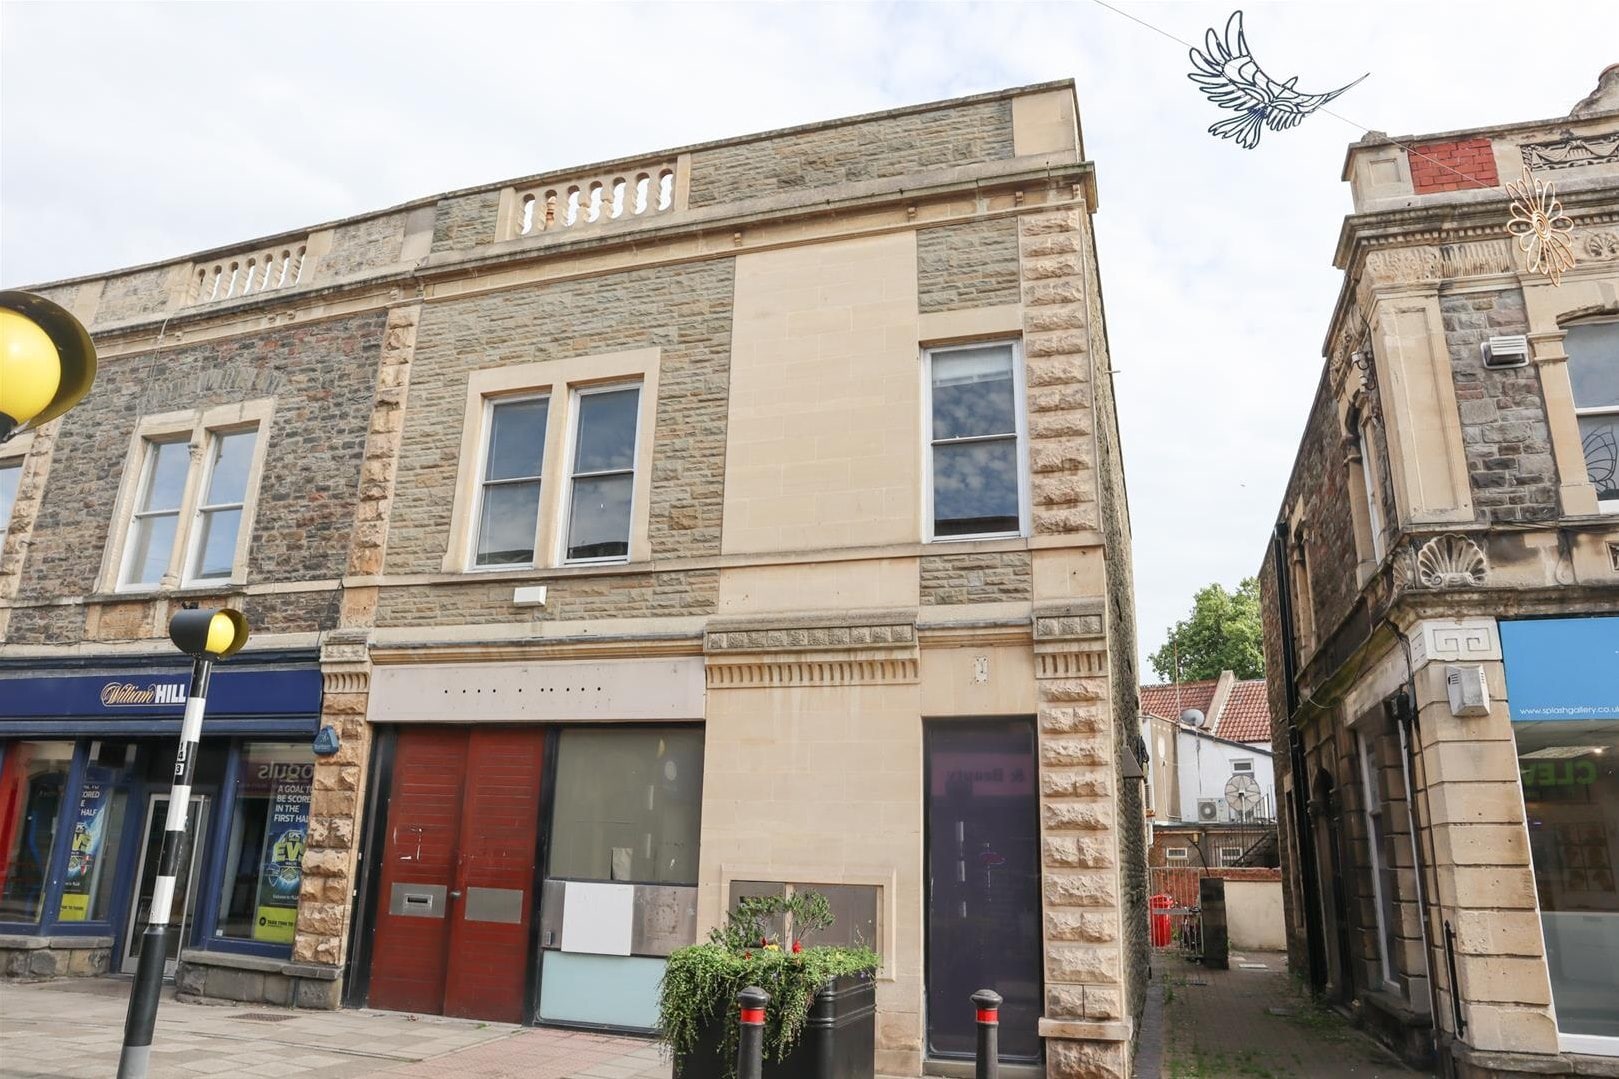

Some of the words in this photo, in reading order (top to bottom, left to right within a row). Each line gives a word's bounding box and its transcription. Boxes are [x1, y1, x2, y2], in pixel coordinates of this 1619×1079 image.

[102, 683, 155, 705] William
[155, 684, 186, 704] HILL
[277, 784, 283, 793] A
[284, 785, 304, 794] GOAL
[276, 794, 287, 803] BE
[287, 794, 312, 803] SCORE
[80, 808, 99, 816] HALF
[275, 804, 284, 813] IN
[285, 804, 300, 813] THE
[274, 814, 295, 823] FIRST
[295, 814, 309, 823] HAL
